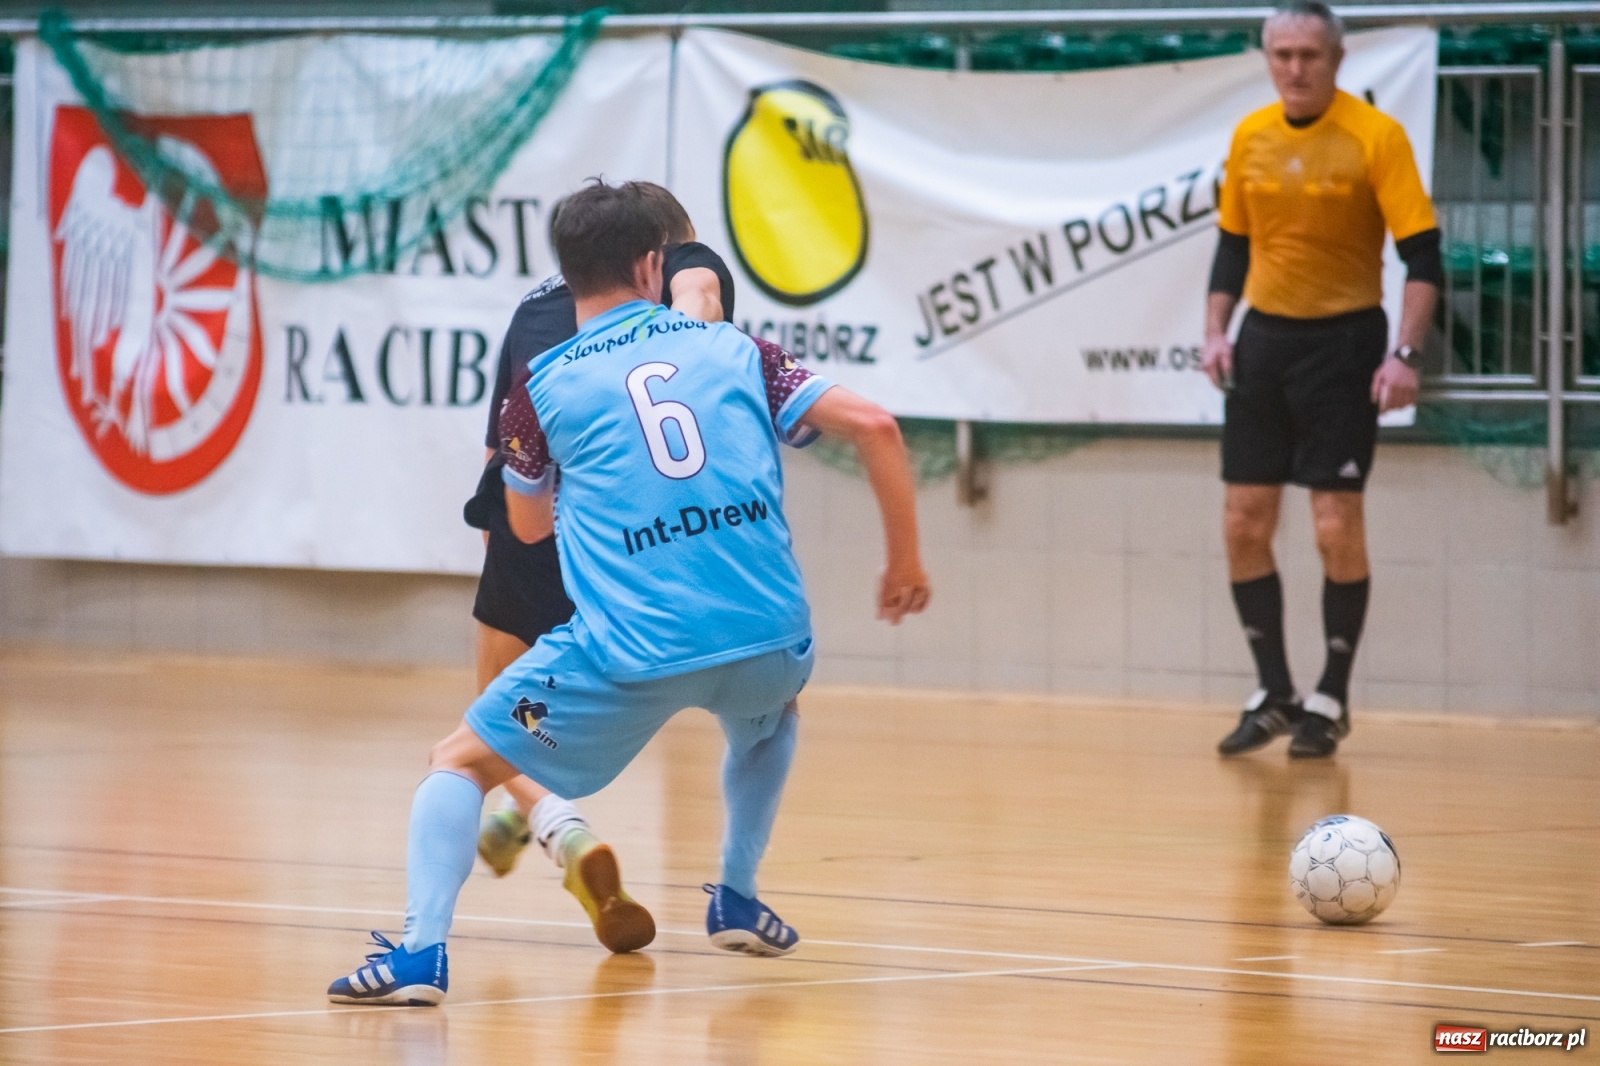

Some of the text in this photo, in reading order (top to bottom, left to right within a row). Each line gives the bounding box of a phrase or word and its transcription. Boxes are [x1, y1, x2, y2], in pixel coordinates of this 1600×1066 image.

[318, 194, 558, 279] MIAST
[914, 165, 1221, 347] JEST W PORZ
[742, 312, 879, 365] CIBÓRZ
[626, 361, 706, 480] 6
[623, 499, 768, 556] Int-Drew
